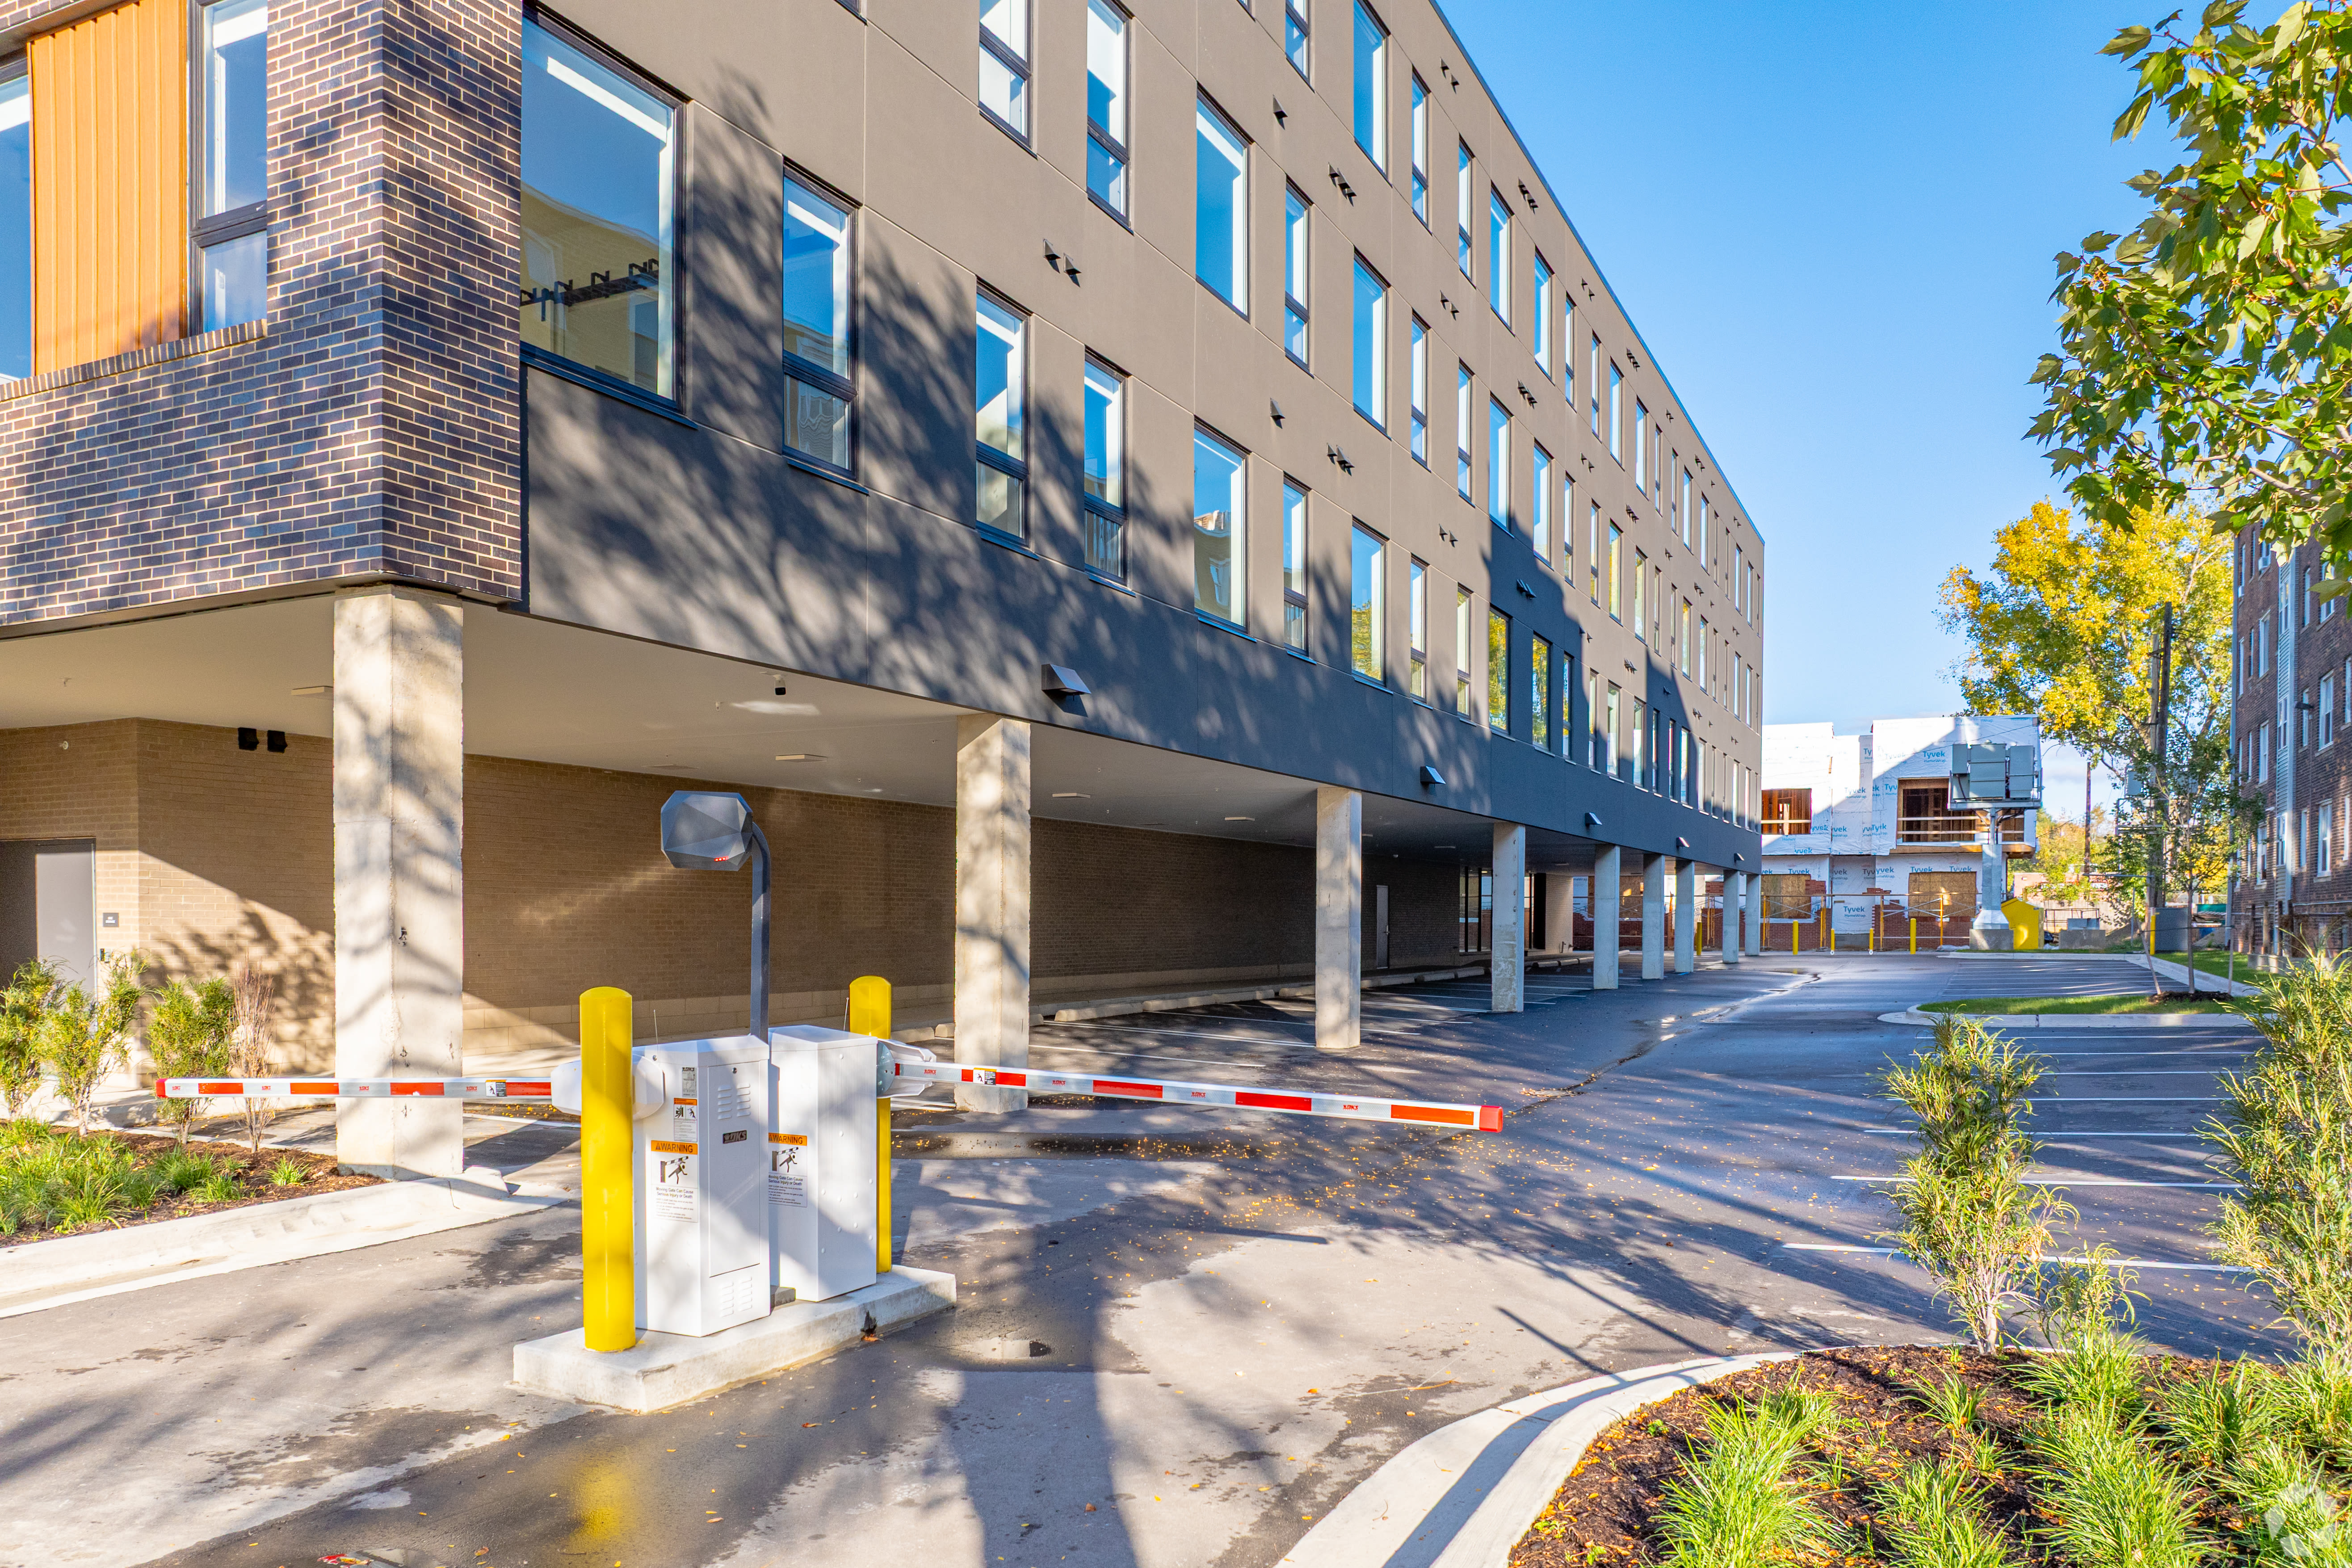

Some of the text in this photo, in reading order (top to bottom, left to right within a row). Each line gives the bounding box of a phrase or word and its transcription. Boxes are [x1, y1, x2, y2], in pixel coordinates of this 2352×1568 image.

[1923, 751, 1945, 759] Tyvek
[1876, 866, 1894, 874] yvek
[728, 1131, 747, 1142] DKS
[773, 1134, 803, 1144] WARNING
[661, 1143, 693, 1153] WARNING
